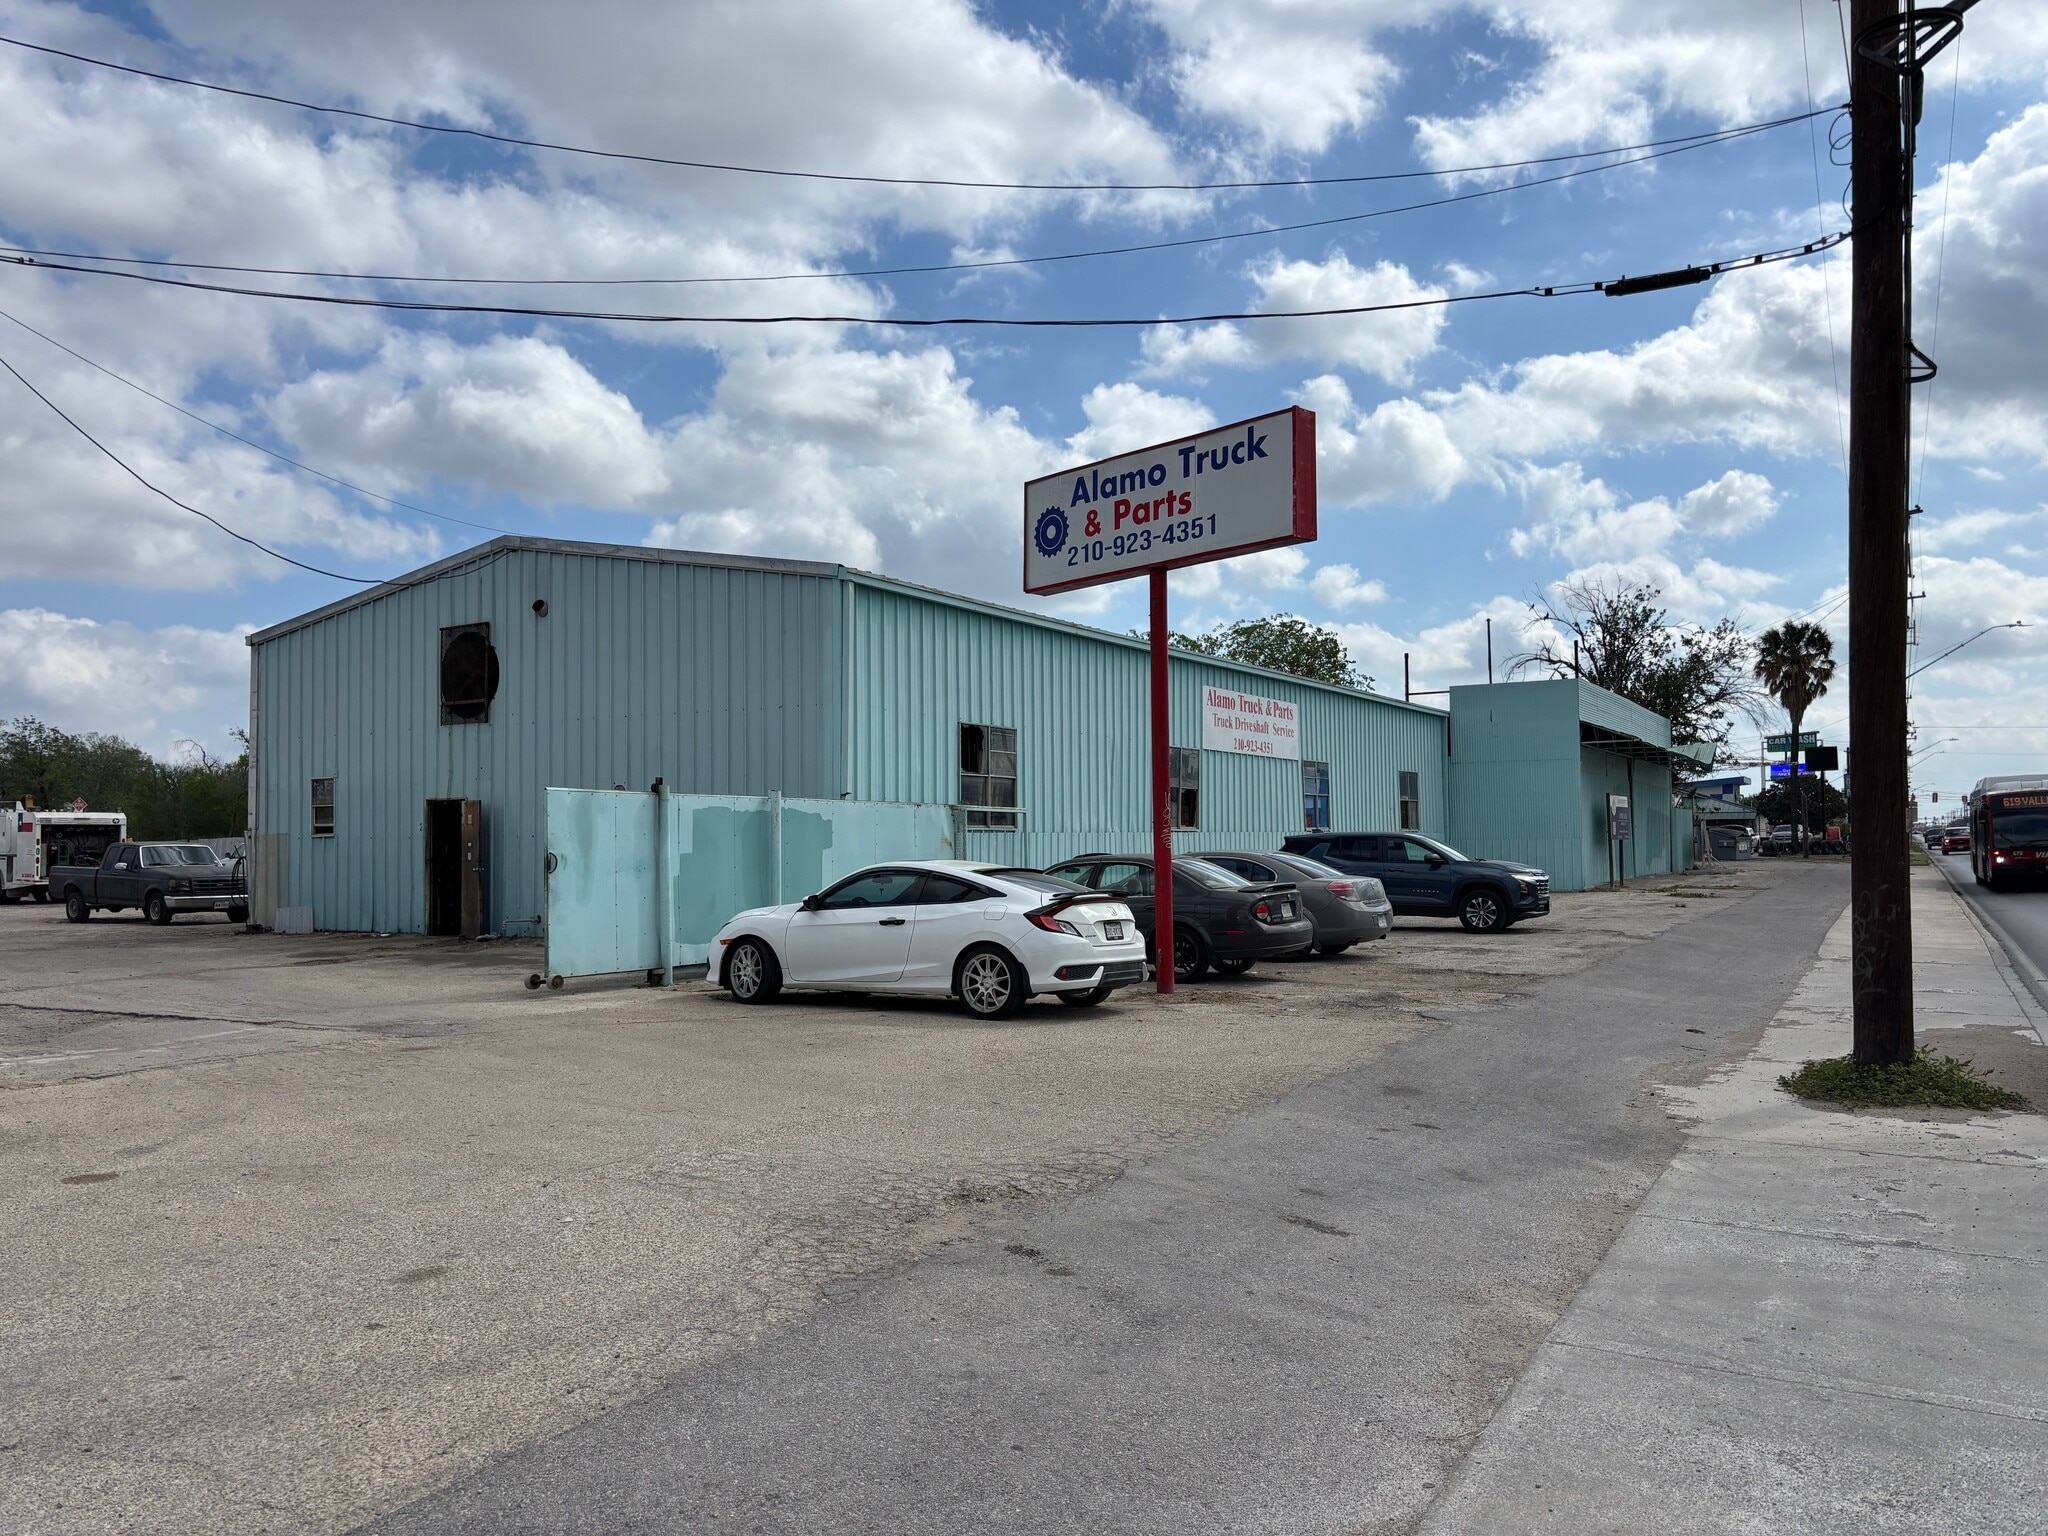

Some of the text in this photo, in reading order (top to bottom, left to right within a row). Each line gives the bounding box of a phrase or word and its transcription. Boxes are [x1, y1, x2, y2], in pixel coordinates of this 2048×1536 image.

[1070, 426, 1269, 508] Alamo Truck
[1084, 489, 1192, 537] & Parts
[1067, 513, 1217, 567] 210-923-4351
[1206, 689, 1294, 720] Alamo Truck & Parts
[1212, 712, 1295, 738] Truck Driveshaft Service
[1233, 737, 1274, 754] 210-923-4351
[1769, 737, 1787, 745] CAR
[2003, 795, 2048, 807] 619 VALL
